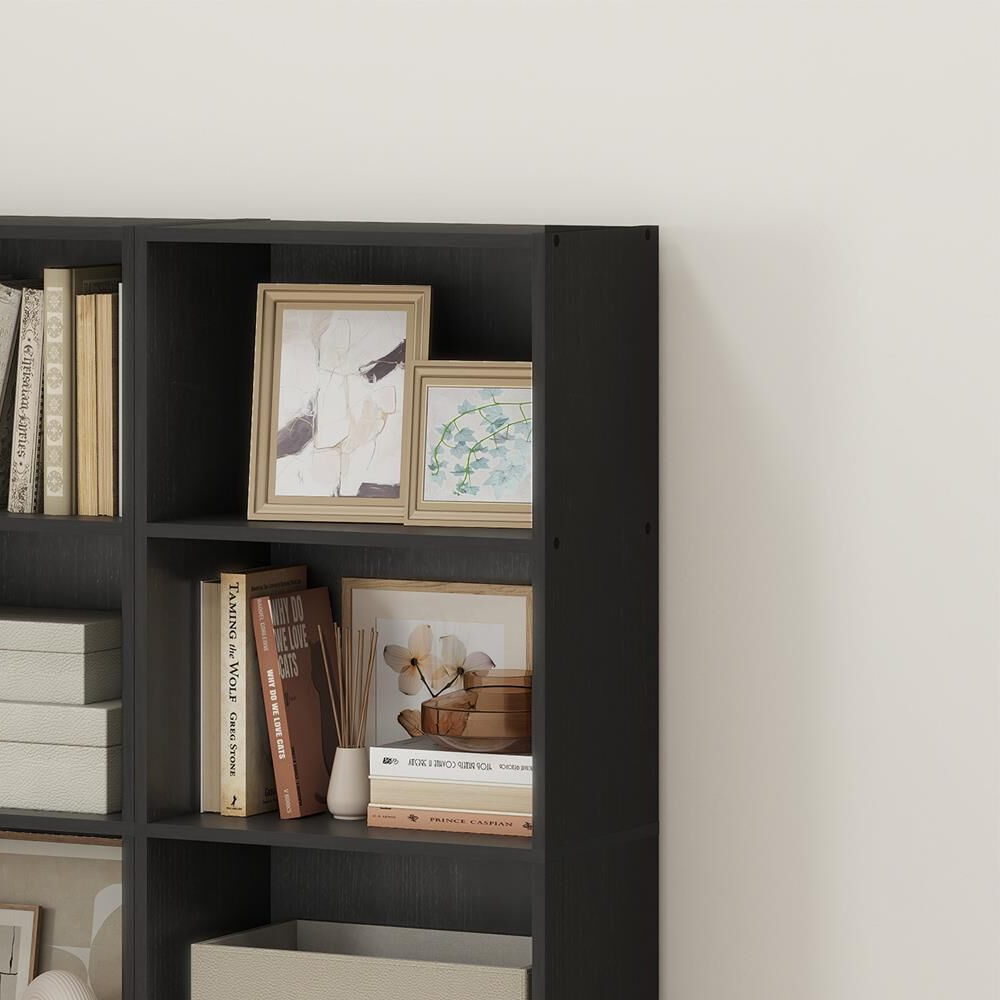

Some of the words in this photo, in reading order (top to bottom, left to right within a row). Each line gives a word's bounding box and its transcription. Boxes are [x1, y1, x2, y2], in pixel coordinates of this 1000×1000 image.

[272, 597, 290, 626] WHY
[290, 594, 304, 622] DO
[274, 627, 288, 653] WE
[287, 623, 309, 651] LOVE
[229, 643, 239, 660] the
[279, 652, 299, 680] CATS
[266, 669, 277, 688] WHY
[269, 690, 278, 702] DO
[271, 703, 280, 718] WE
[273, 718, 283, 738] LOVE
[276, 739, 286, 760] CATS
[429, 817, 466, 825] PRINCE
[469, 820, 514, 828] CASPIAN
